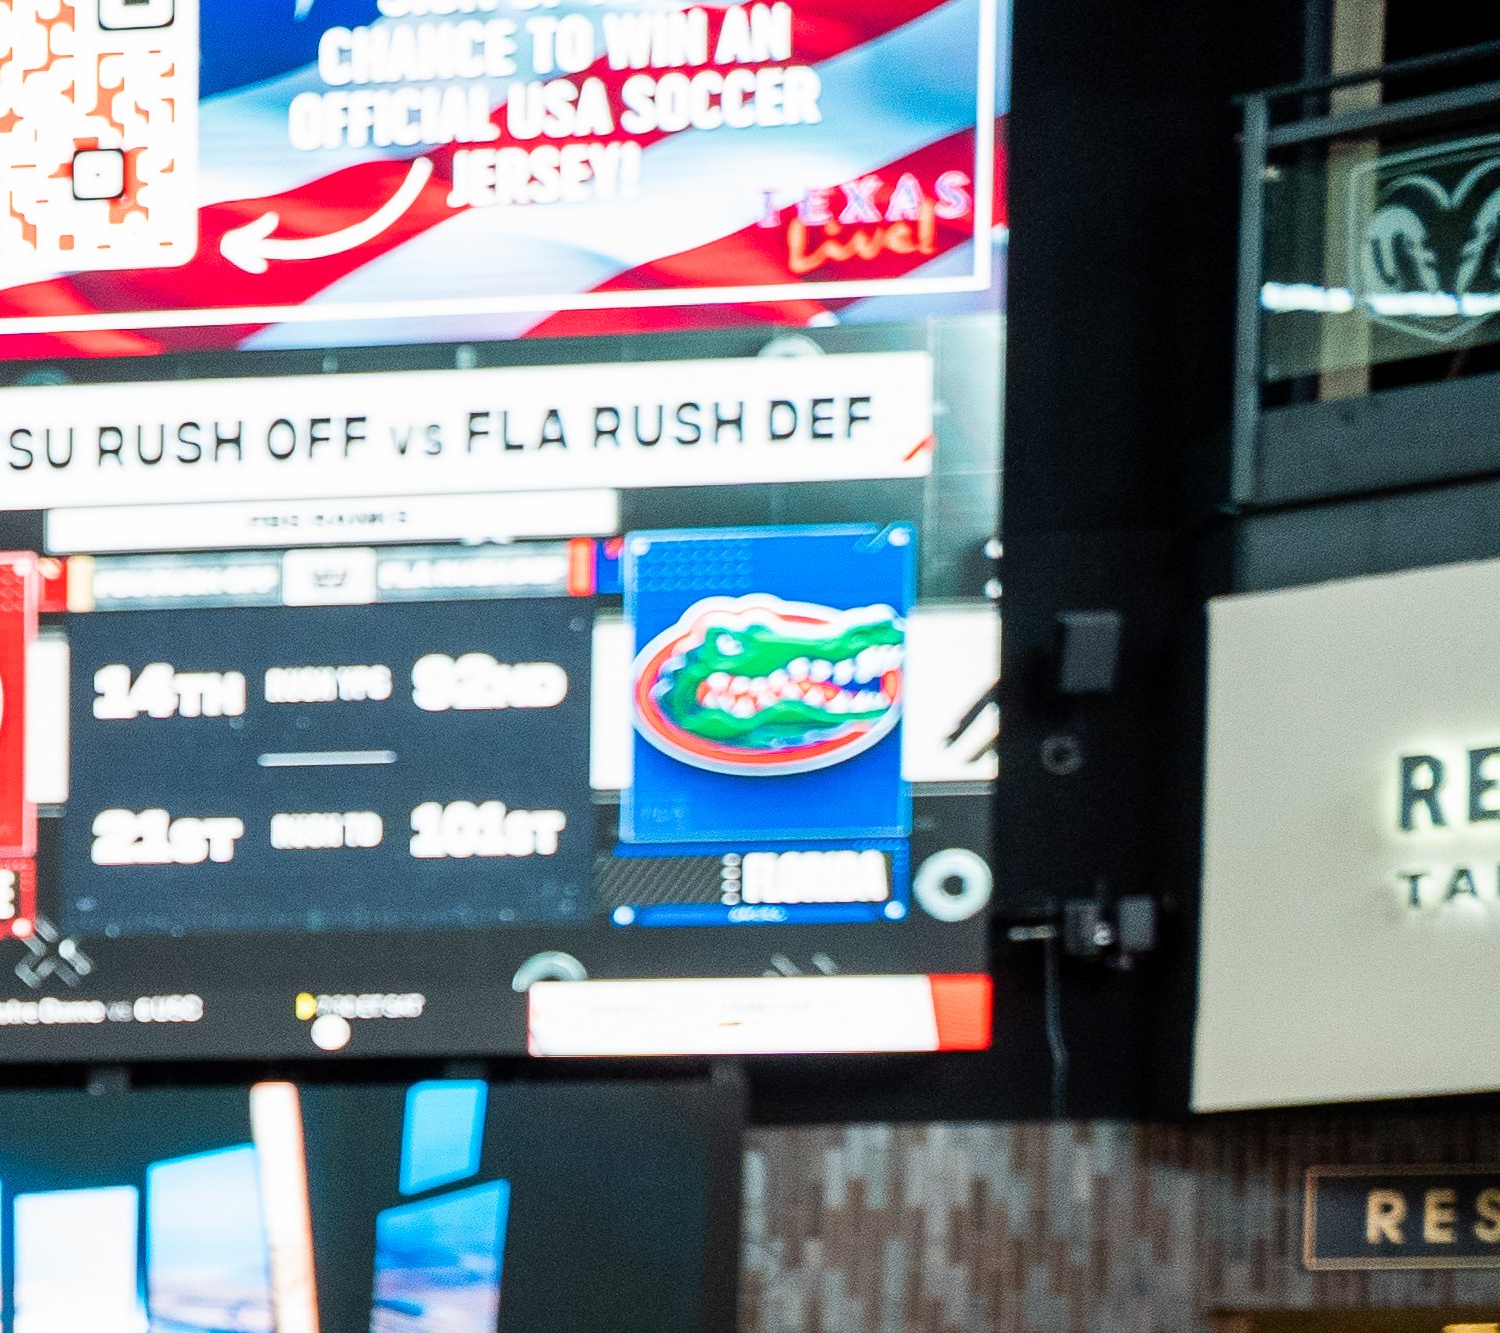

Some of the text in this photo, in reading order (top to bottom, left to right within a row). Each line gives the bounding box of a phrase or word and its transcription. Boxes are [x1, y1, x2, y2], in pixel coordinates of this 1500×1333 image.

[317, 1, 792, 86] CHANCE TO WIN AN
[288, 65, 822, 150] OFFICIAL USA SOCCER
[446, 140, 642, 209] JERSEY!
[757, 170, 972, 229] TEXAS
[97, 420, 246, 466] RUSH
[267, 415, 369, 460] OFF
[466, 408, 570, 454] FLA
[593, 400, 745, 449] RUSH
[768, 395, 873, 441] DEF
[1399, 866, 1500, 909] TA
